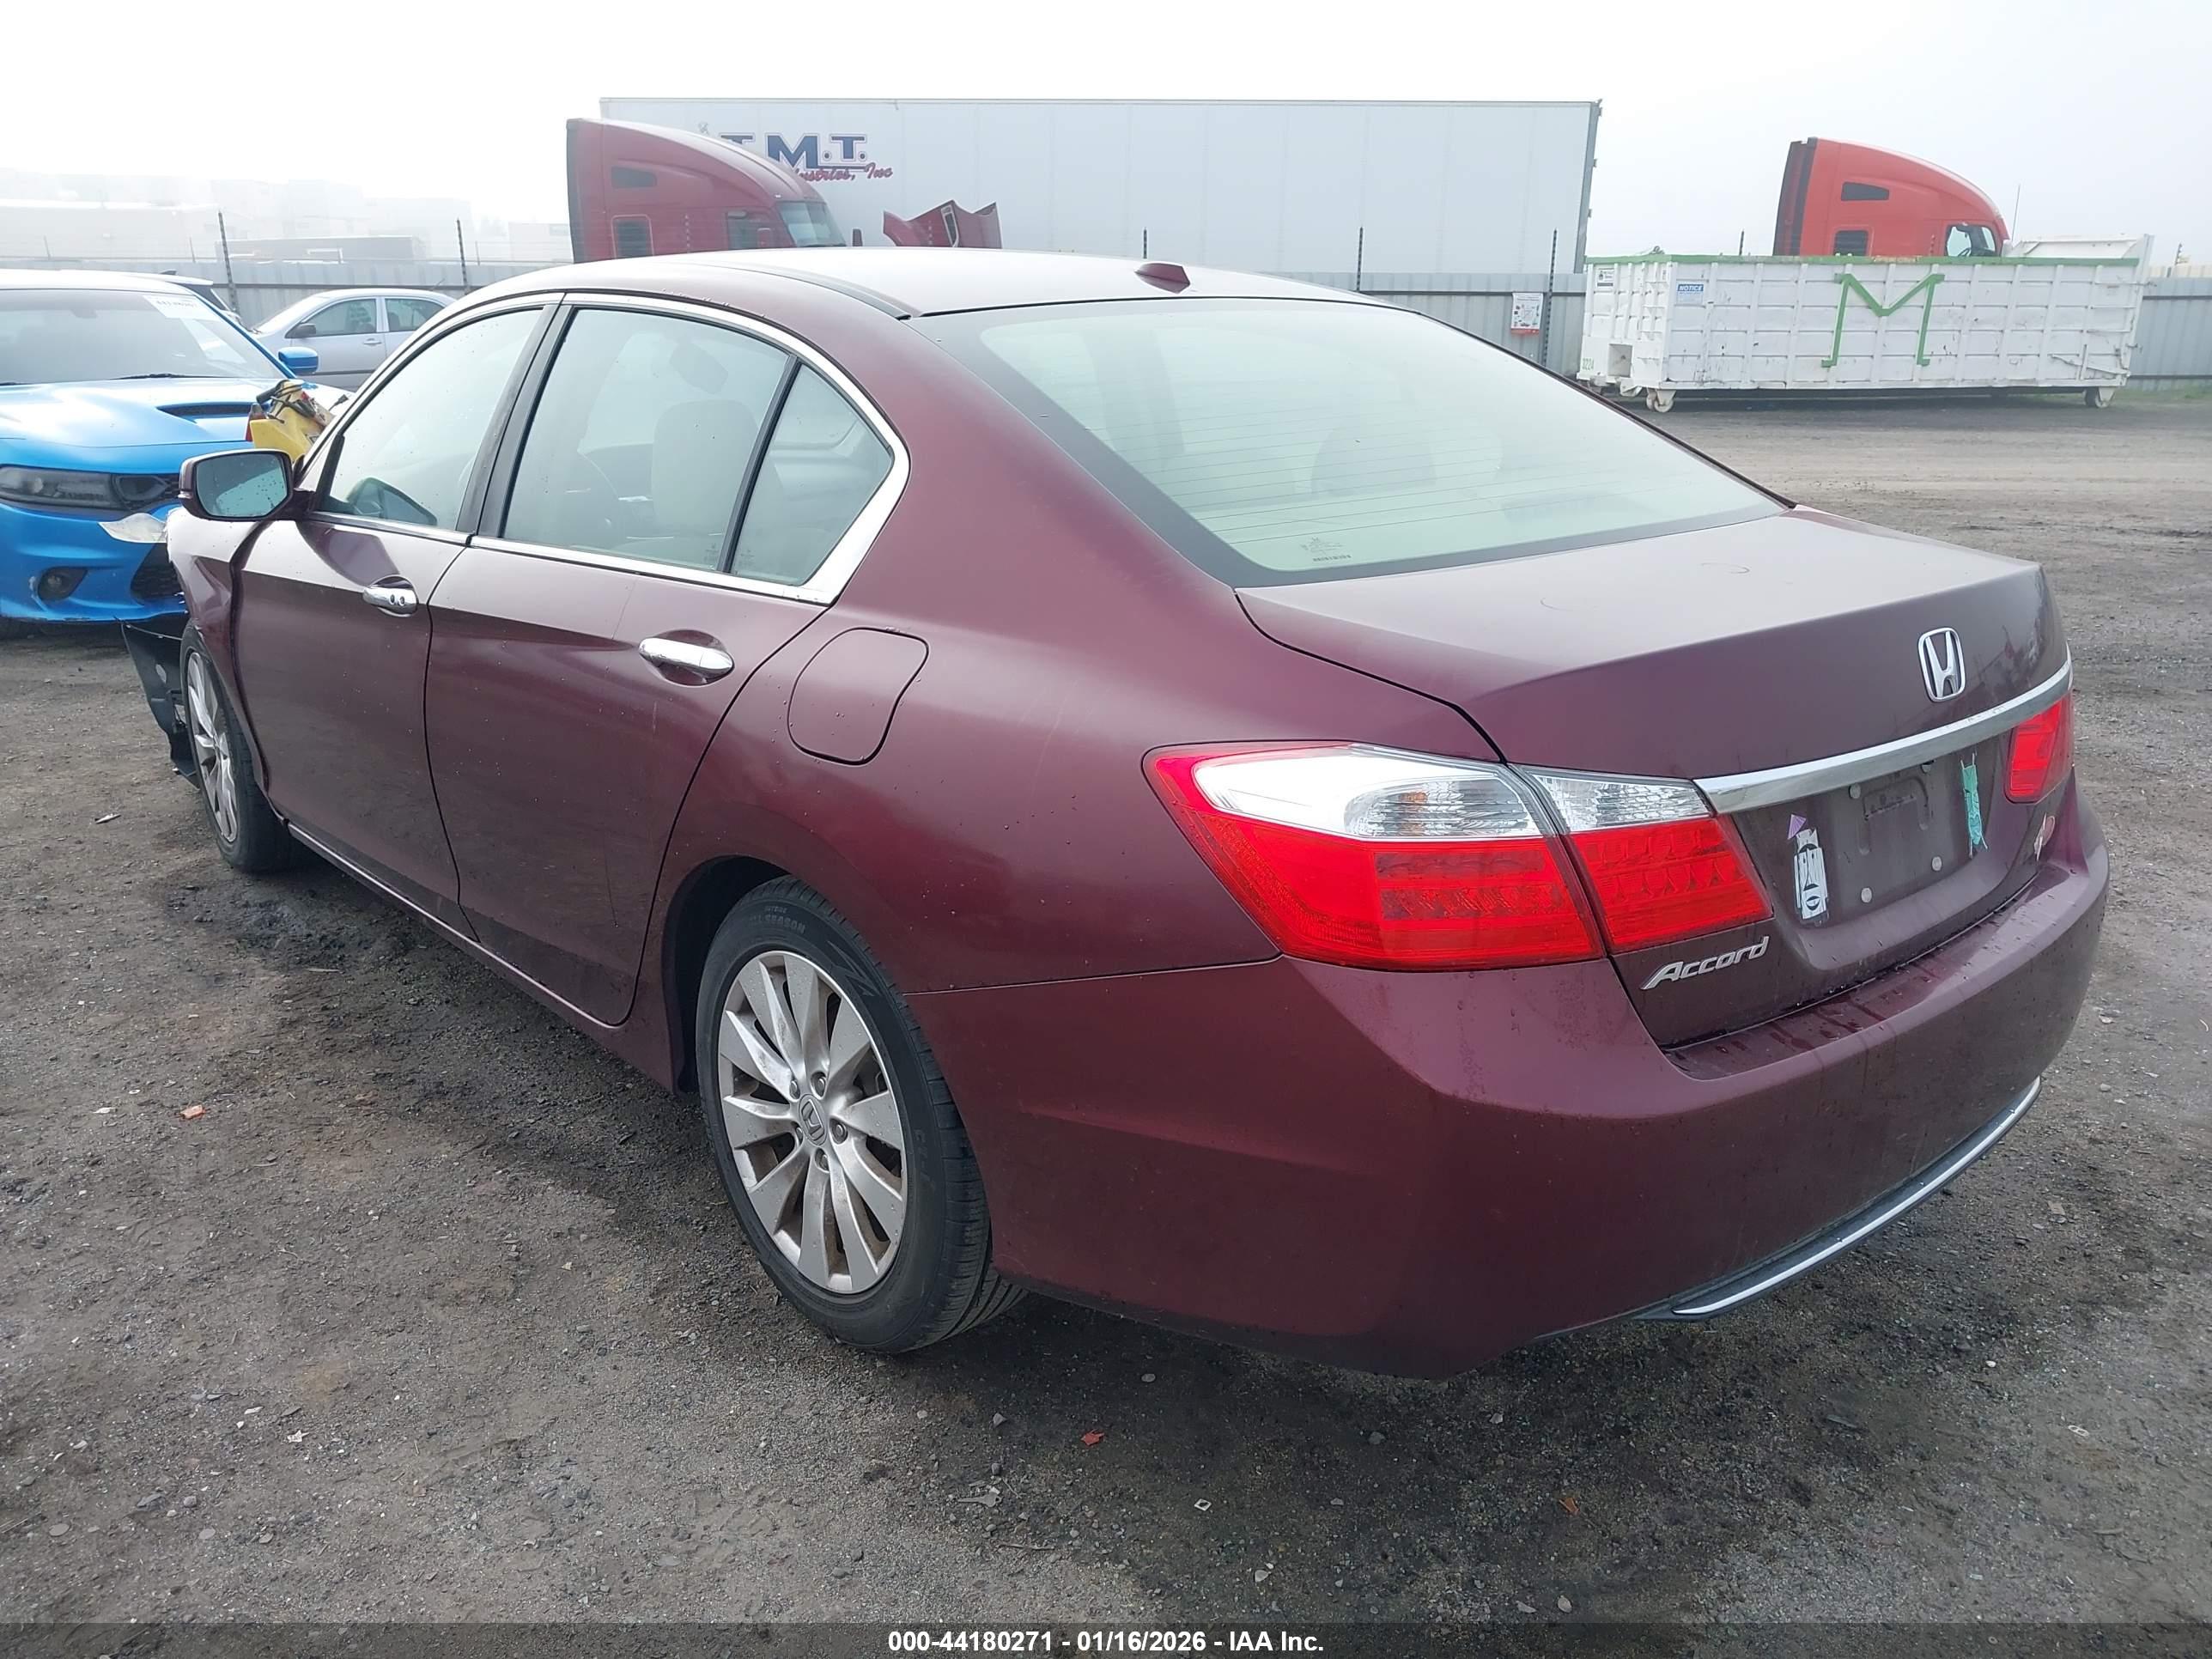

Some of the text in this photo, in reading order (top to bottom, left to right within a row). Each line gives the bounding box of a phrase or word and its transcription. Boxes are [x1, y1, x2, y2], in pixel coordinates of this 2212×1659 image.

[720, 133, 866, 169] TM.T.
[794, 167, 855, 182] ustries,
[1641, 935, 1770, 990] Accord
